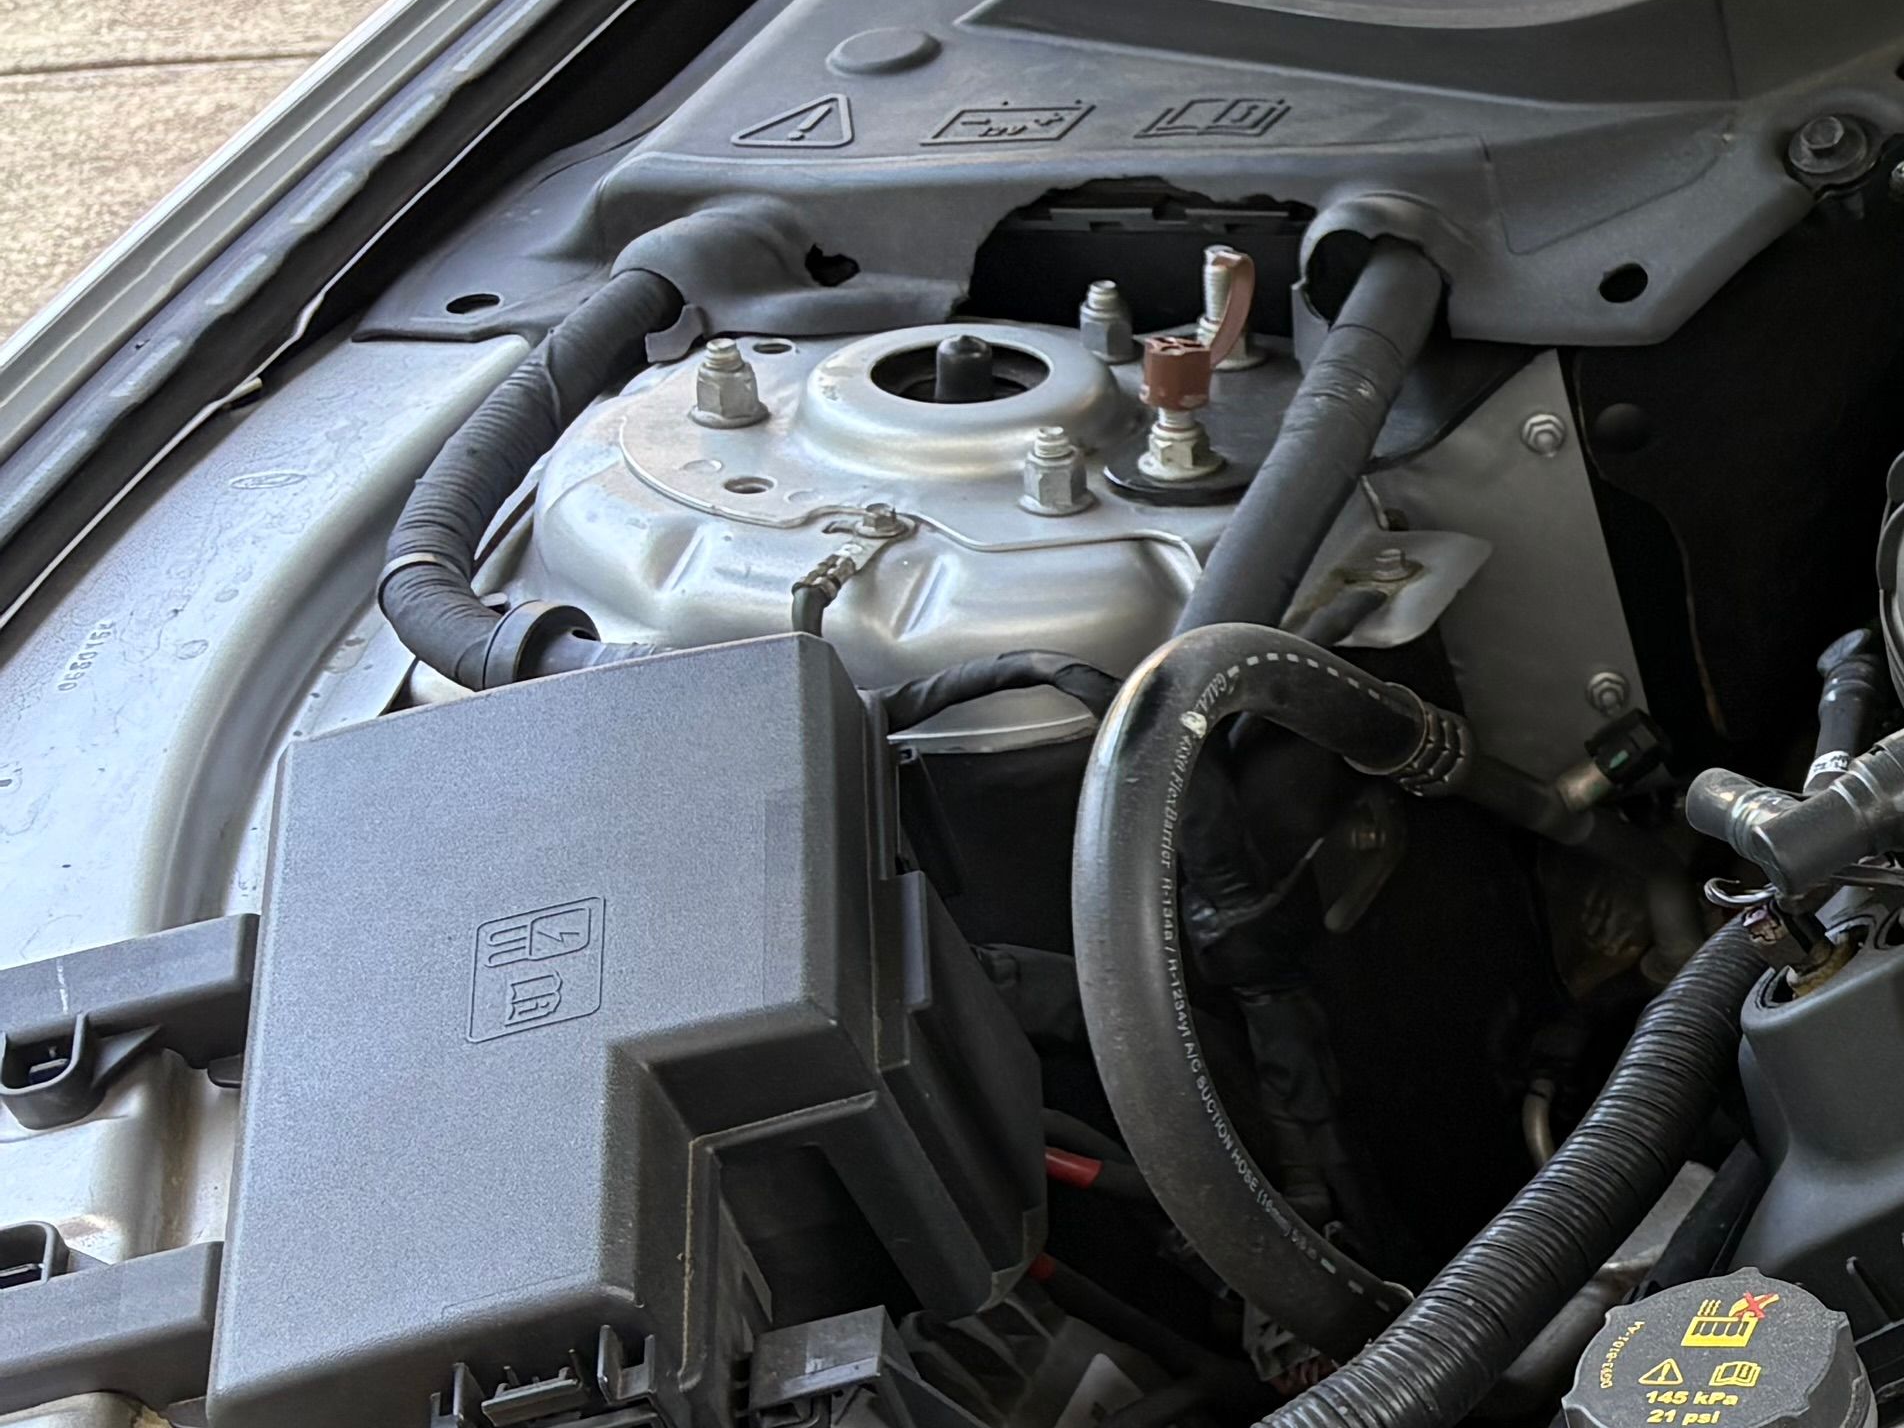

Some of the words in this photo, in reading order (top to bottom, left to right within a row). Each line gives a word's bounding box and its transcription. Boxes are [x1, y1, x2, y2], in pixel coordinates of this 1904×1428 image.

[1194, 1074, 1232, 1151] SUCTION
[1229, 1147, 1260, 1193] HOSE
[1645, 1389, 1690, 1405] 145
[1692, 1390, 1739, 1407] kPa
[1646, 1408, 1678, 1424] 21
[1681, 1410, 1722, 1426] psi
